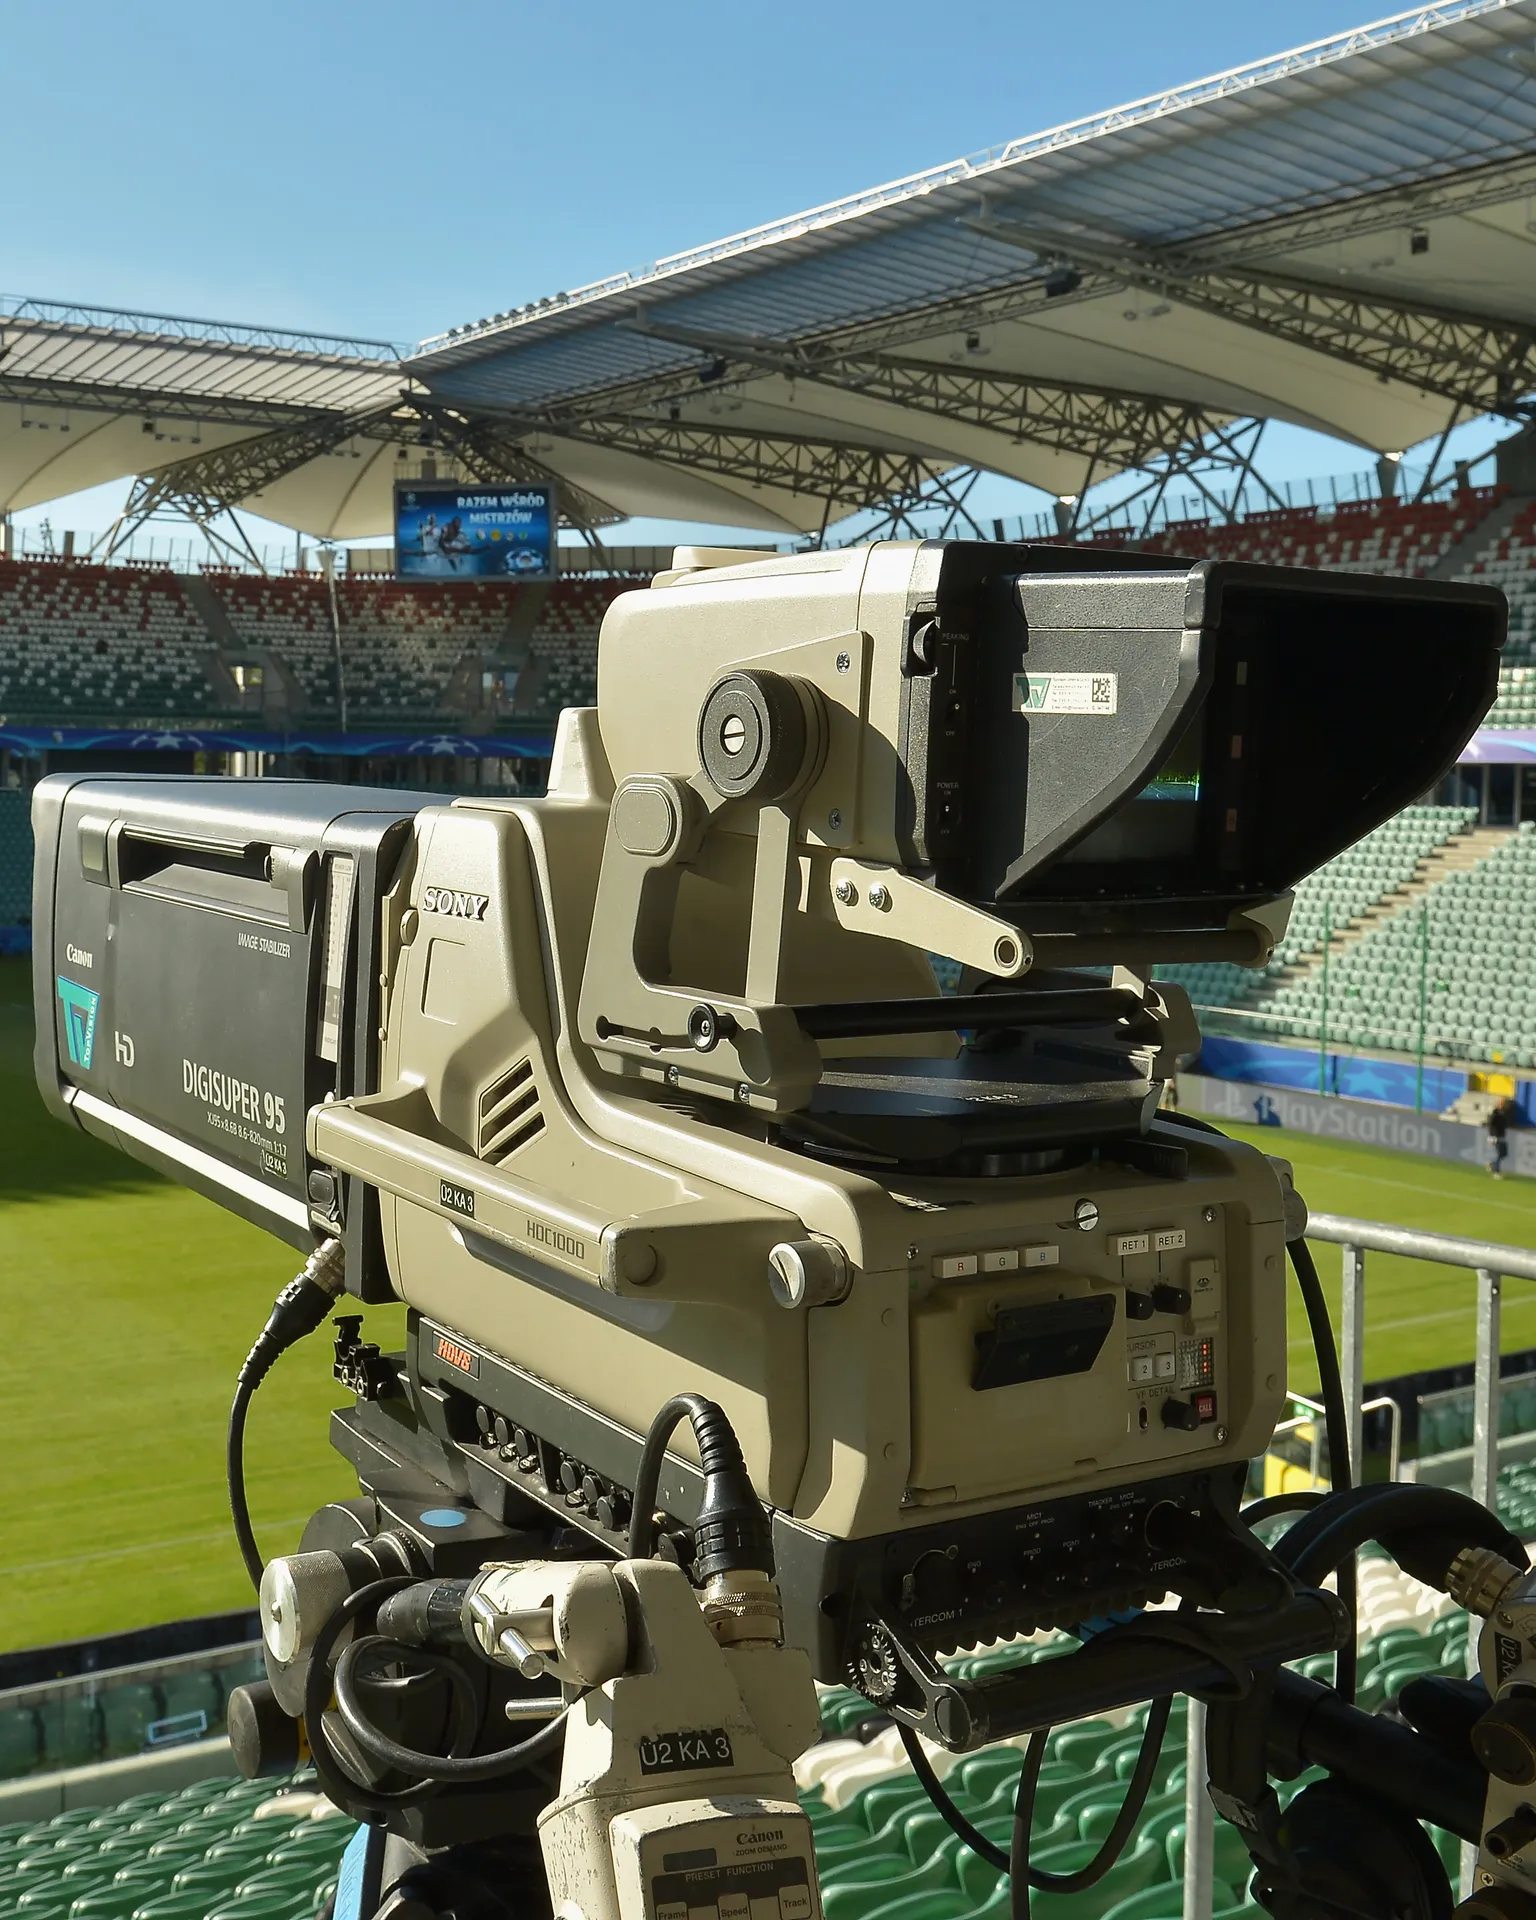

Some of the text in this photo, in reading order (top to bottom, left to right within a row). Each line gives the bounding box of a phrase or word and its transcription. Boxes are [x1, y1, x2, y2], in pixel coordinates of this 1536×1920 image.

[457, 492, 545, 509] RAZEM WŚRÓD
[469, 509, 532, 524] MISTRZÓW
[942, 632, 970, 641] PEAKING
[423, 886, 489, 922] SONY
[237, 932, 291, 959] IMAGE STABILIZER
[66, 943, 93, 969] Canon
[183, 1058, 286, 1134] DIGISUPER 95
[1261, 1091, 1441, 1153] PlayStation
[454, 1190, 466, 1210] KA
[467, 1195, 474, 1212] 3
[1122, 1240, 1139, 1250] RET
[1158, 1236, 1175, 1246] RET
[998, 1257, 1006, 1267] G
[1040, 1252, 1046, 1261] B
[957, 1262, 964, 1271] R
[1148, 1386, 1175, 1398] DETAIL
[1026, 1511, 1042, 1520] MIC1
[678, 1738, 711, 1762] KA
[715, 1736, 731, 1758] 3
[736, 1829, 784, 1845] Canon
[735, 1843, 788, 1857] ZOOM DEMAND
[685, 1862, 774, 1883] PRESET FUNCTION
[783, 1897, 808, 1909] Track
[658, 1911, 686, 1920] Frame
[720, 1906, 749, 1918] Speed
